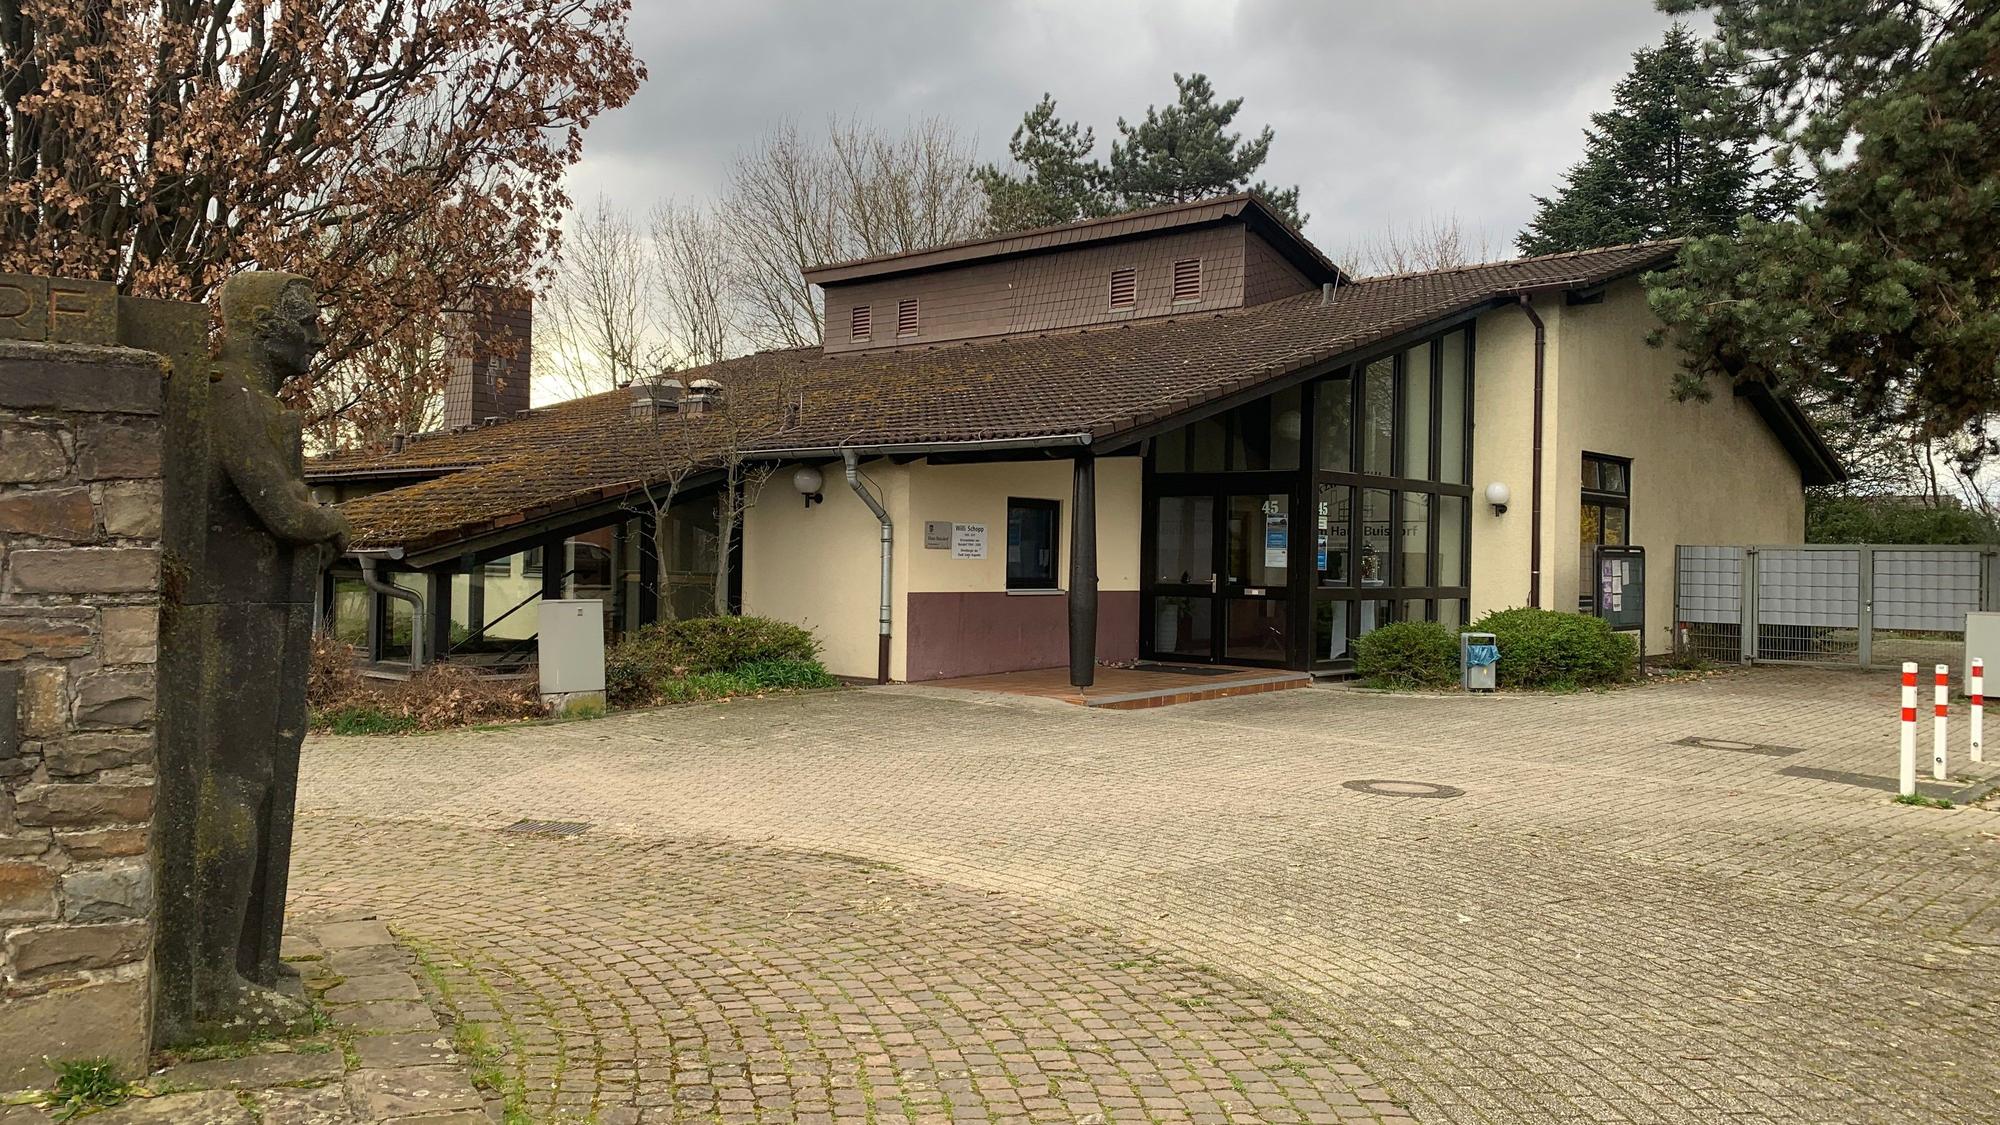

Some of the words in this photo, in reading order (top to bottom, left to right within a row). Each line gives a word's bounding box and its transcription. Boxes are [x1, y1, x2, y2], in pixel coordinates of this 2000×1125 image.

[1262, 500, 1279, 514] 45
[1318, 501, 1328, 515] 45
[967, 525, 984, 533] Schopp
[1363, 525, 1418, 536] Buisorf
